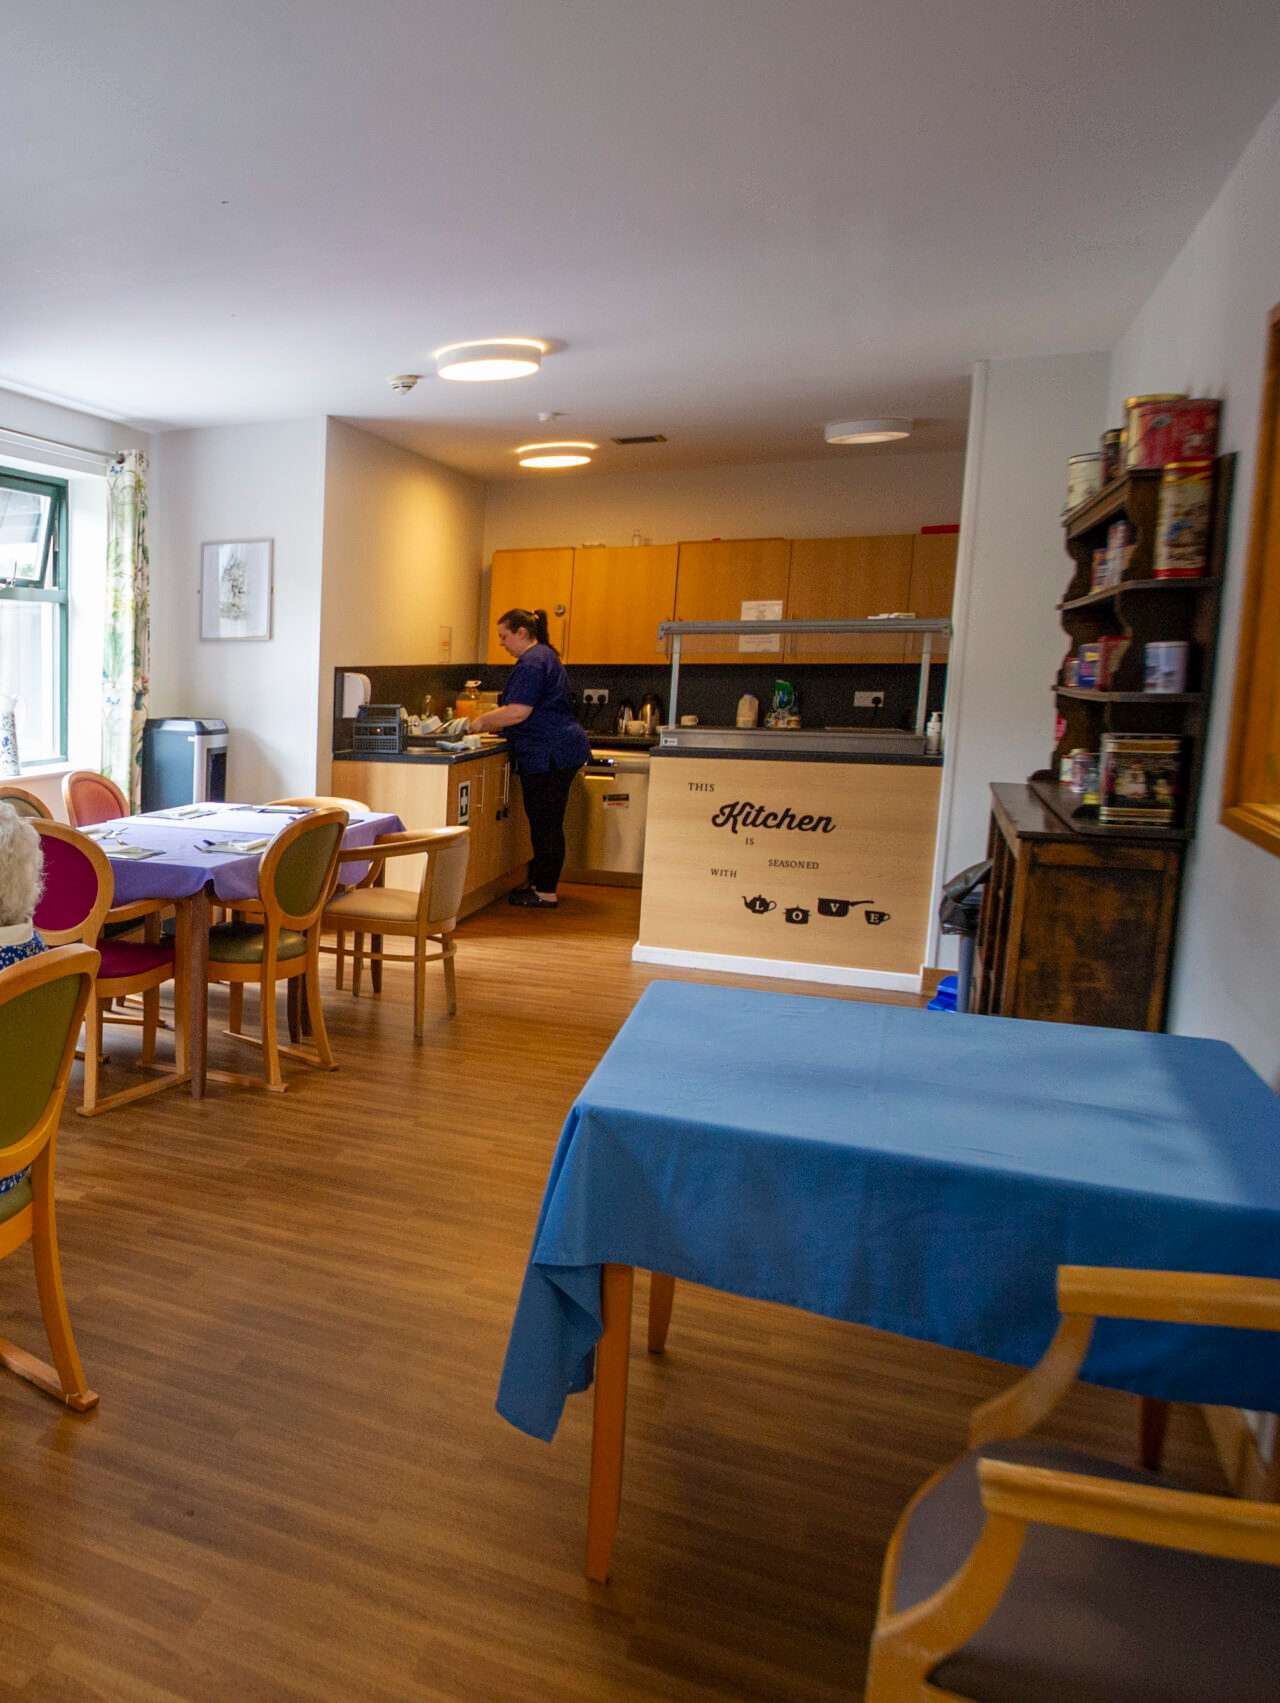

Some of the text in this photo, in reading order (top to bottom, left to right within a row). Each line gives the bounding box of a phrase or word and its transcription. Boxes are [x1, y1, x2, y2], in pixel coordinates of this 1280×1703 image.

[687, 782, 715, 793] THIS
[711, 800, 837, 834] Kitchen
[745, 837, 755, 846] IS
[767, 858, 820, 870] SEASONED
[710, 868, 737, 879] WITH
